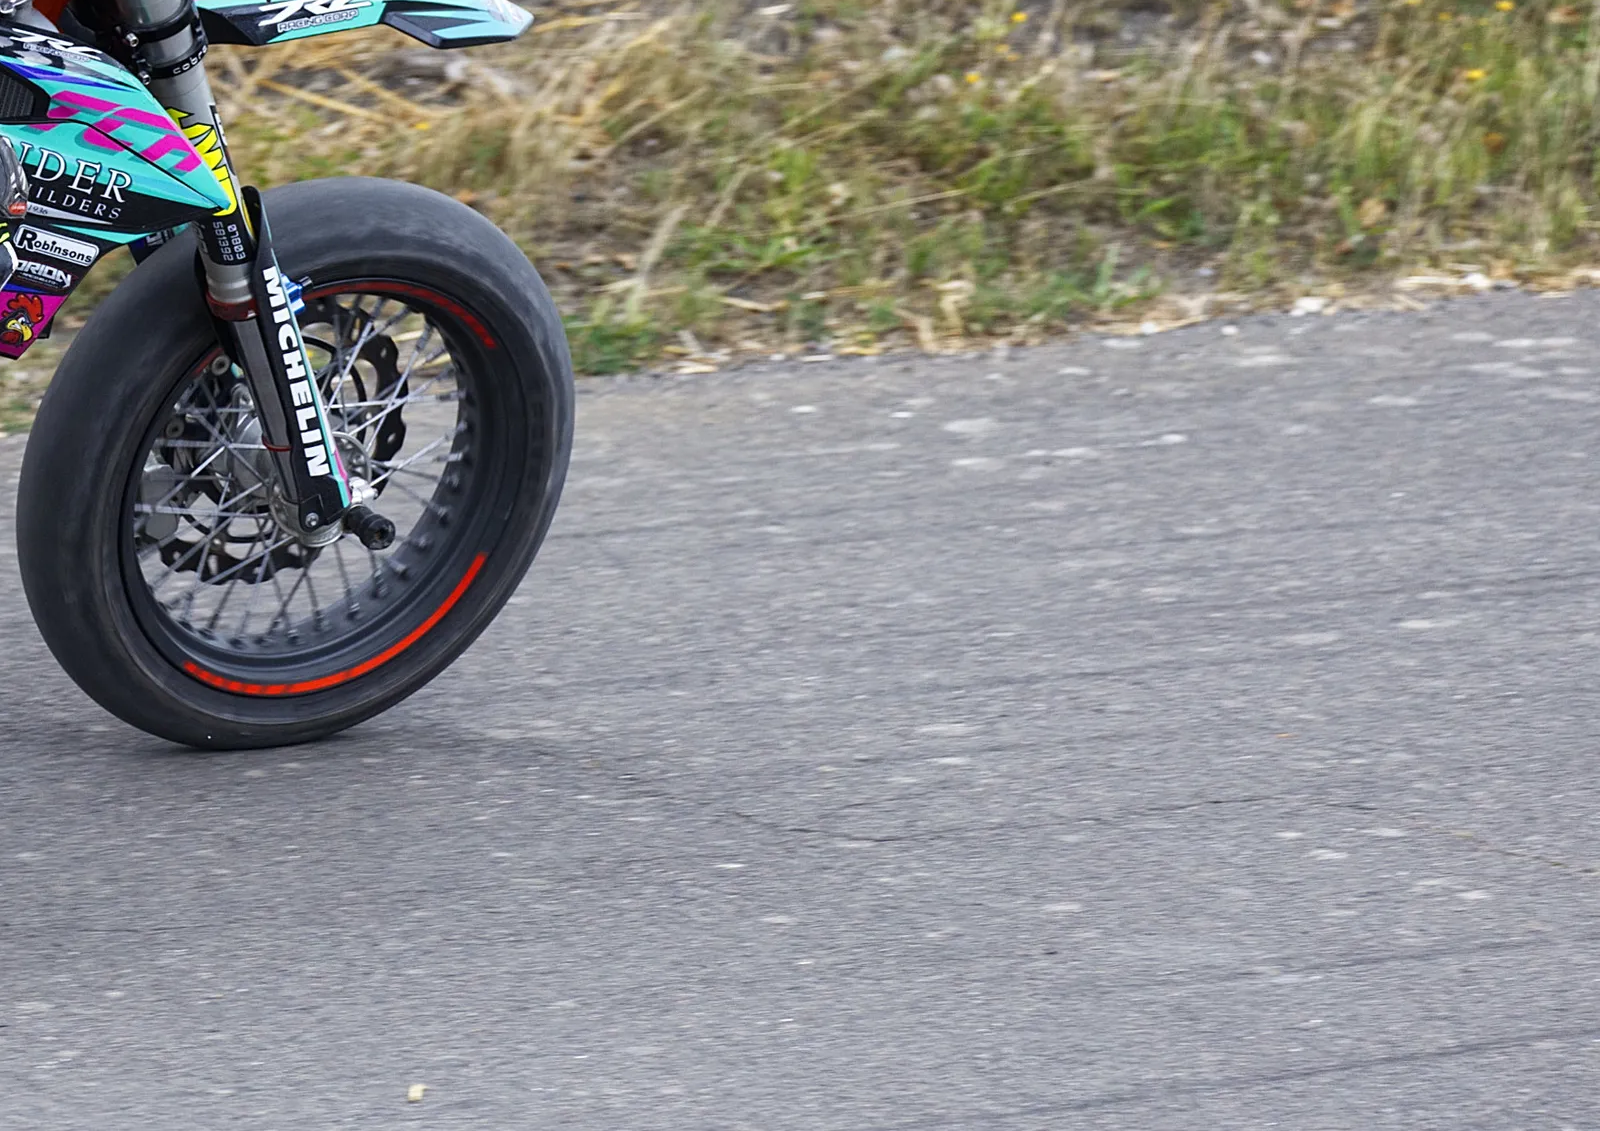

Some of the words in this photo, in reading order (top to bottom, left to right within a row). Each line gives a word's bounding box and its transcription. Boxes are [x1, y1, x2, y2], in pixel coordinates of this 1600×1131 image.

[277, 16, 323, 32] RACING
[323, 9, 358, 24] CORP
[172, 45, 208, 75] cobra
[27, 184, 121, 219] ILDERS
[17, 229, 93, 263] Robinsons
[213, 221, 234, 261] 581392
[262, 266, 330, 477] MICHELIN
